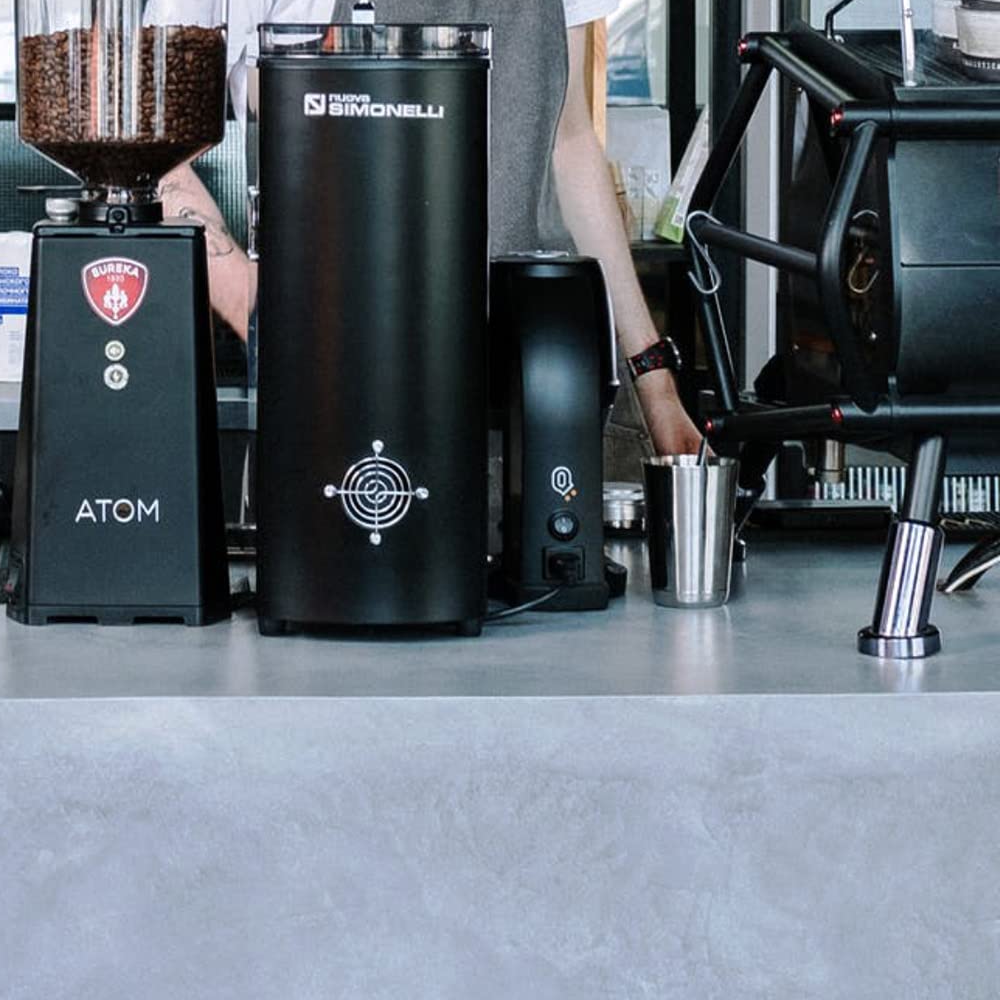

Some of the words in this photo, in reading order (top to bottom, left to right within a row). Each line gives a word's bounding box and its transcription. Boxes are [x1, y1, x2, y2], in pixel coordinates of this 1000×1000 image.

[328, 102, 445, 119] SIMONELLI
[90, 262, 140, 279] EUREKA
[75, 498, 160, 523] ATOM
